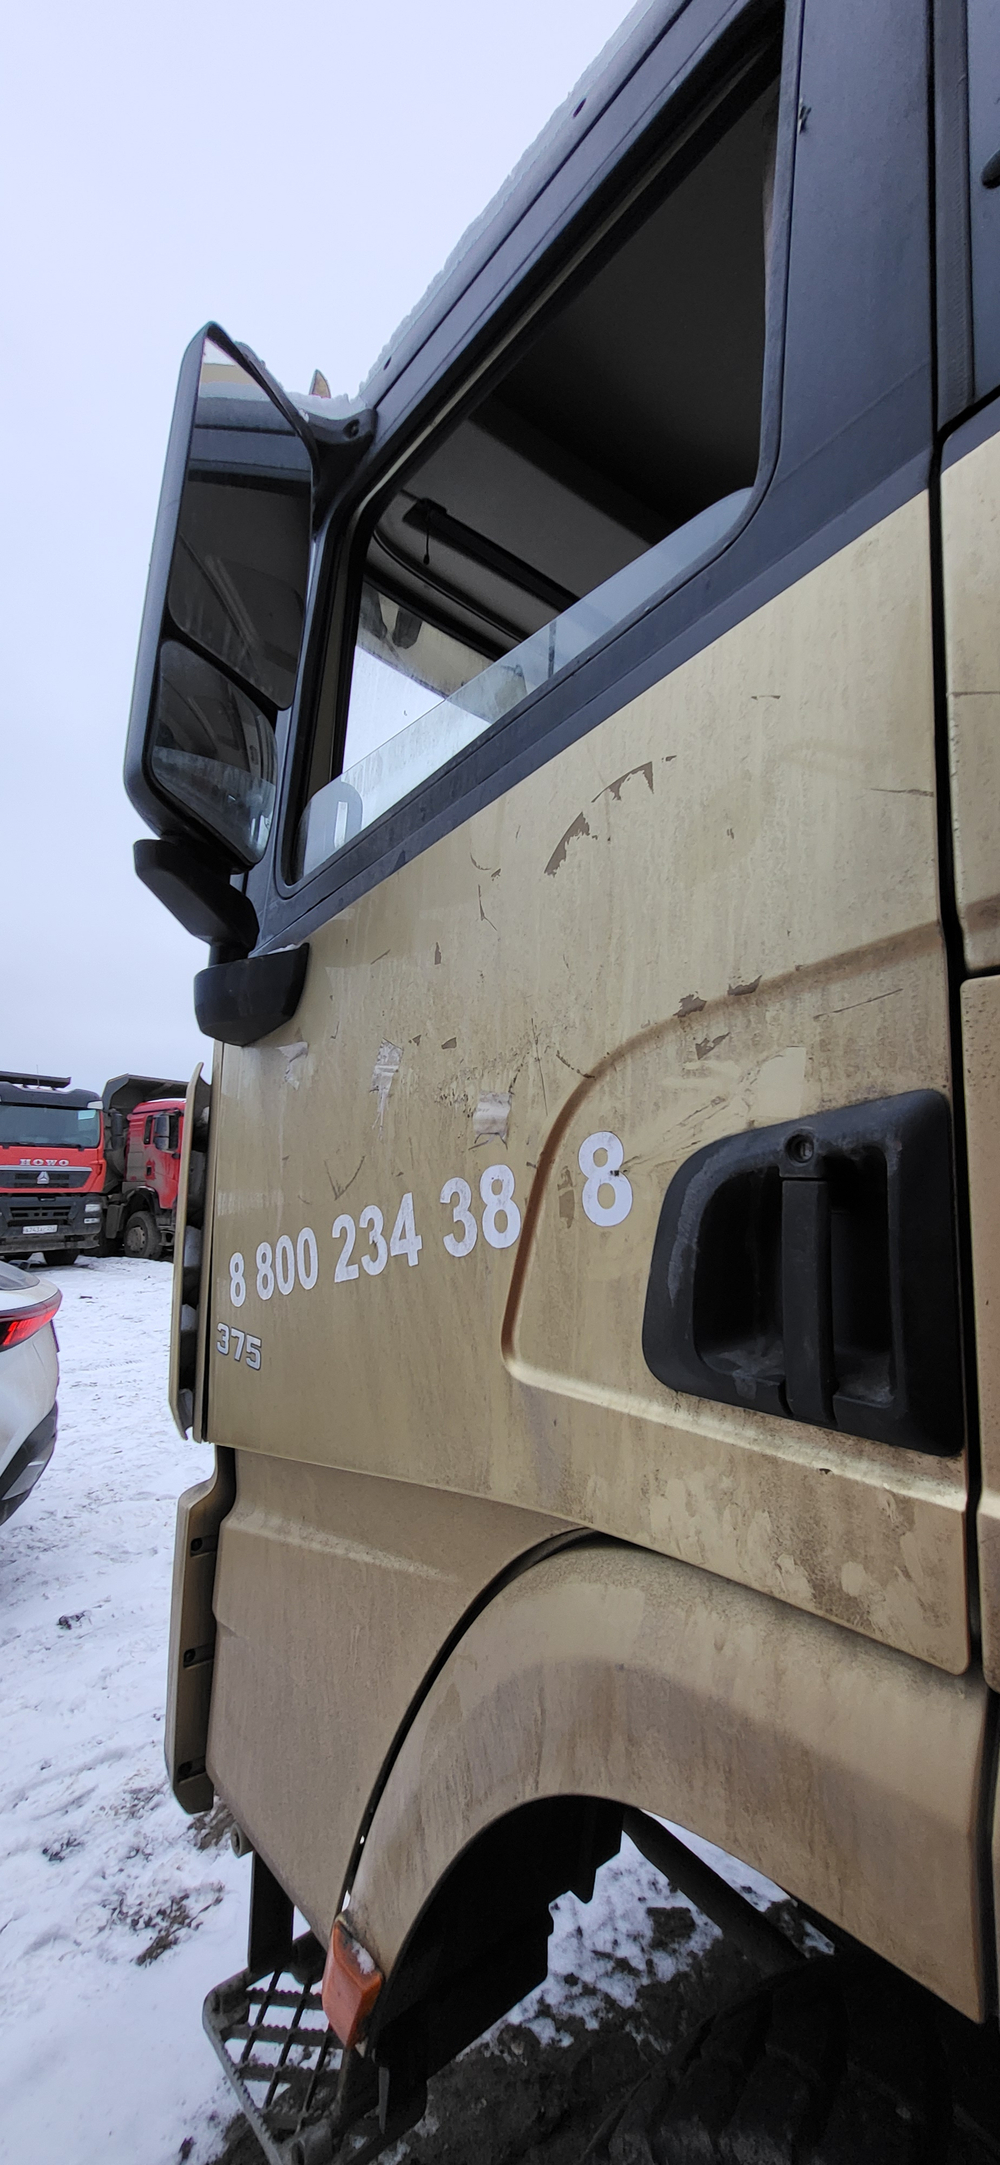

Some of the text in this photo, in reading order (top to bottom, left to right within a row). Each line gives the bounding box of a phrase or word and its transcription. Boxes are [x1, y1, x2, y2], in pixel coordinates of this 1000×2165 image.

[20, 1158, 69, 1166] HOWO
[230, 1251, 246, 1307] 8
[256, 1227, 318, 1300] 800
[332, 1192, 422, 1283] 234
[440, 1164, 521, 1258] 38
[216, 1322, 262, 1370] 375
